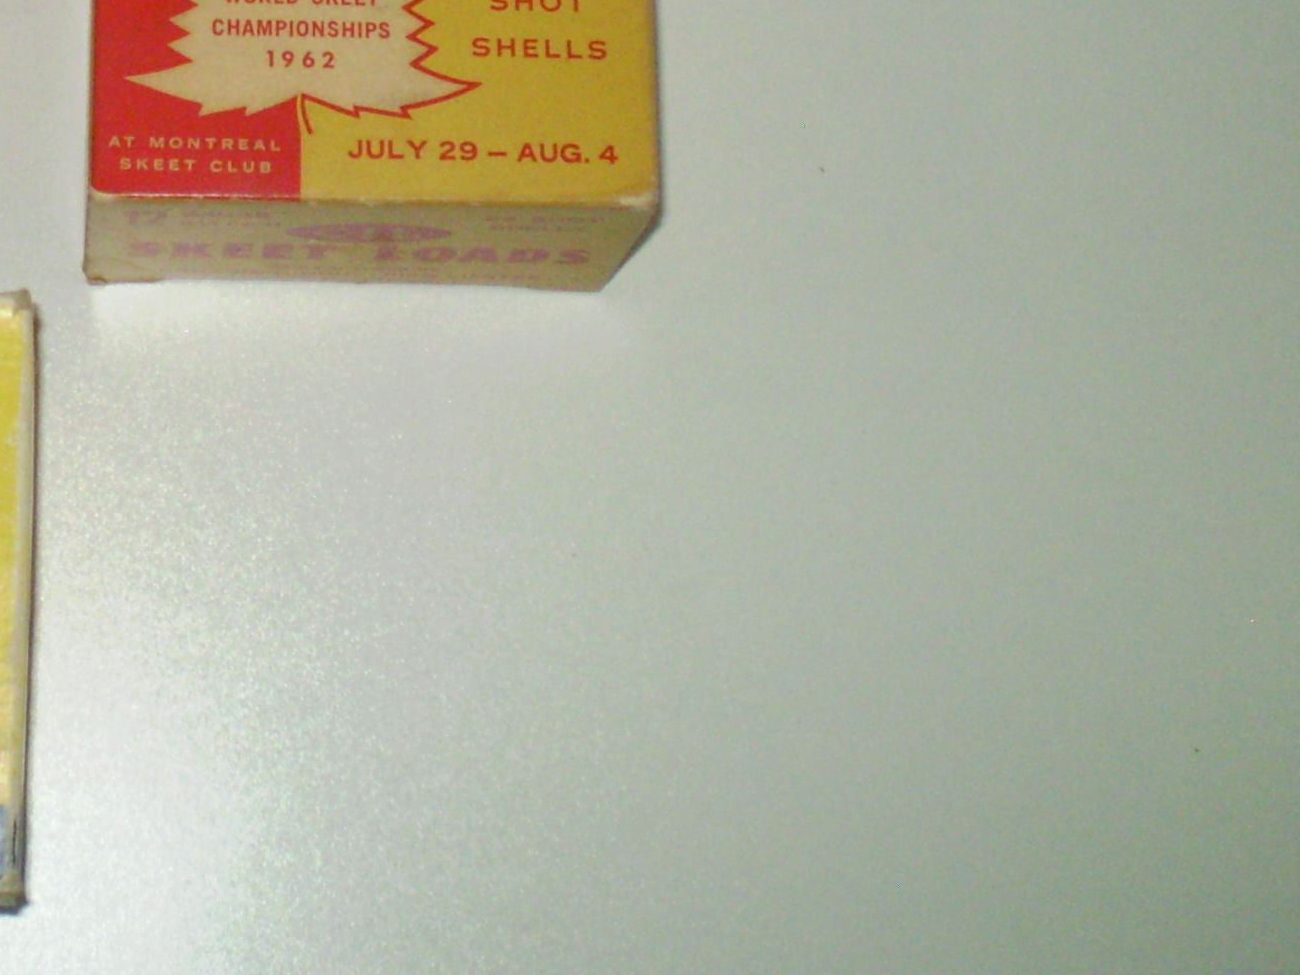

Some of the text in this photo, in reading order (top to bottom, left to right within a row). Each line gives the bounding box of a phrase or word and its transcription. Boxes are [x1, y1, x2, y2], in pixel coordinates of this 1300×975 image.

[211, 19, 391, 39] CHAMPIONSHIPS
[472, 38, 608, 60] SHELLS
[266, 50, 336, 69] 1962
[109, 136, 281, 152] AT MONTREAL
[348, 139, 428, 160] JULY
[439, 140, 478, 161] 29
[517, 143, 590, 164] AUG.
[599, 144, 618, 165] 4
[119, 158, 272, 174] SKEET CLUB
